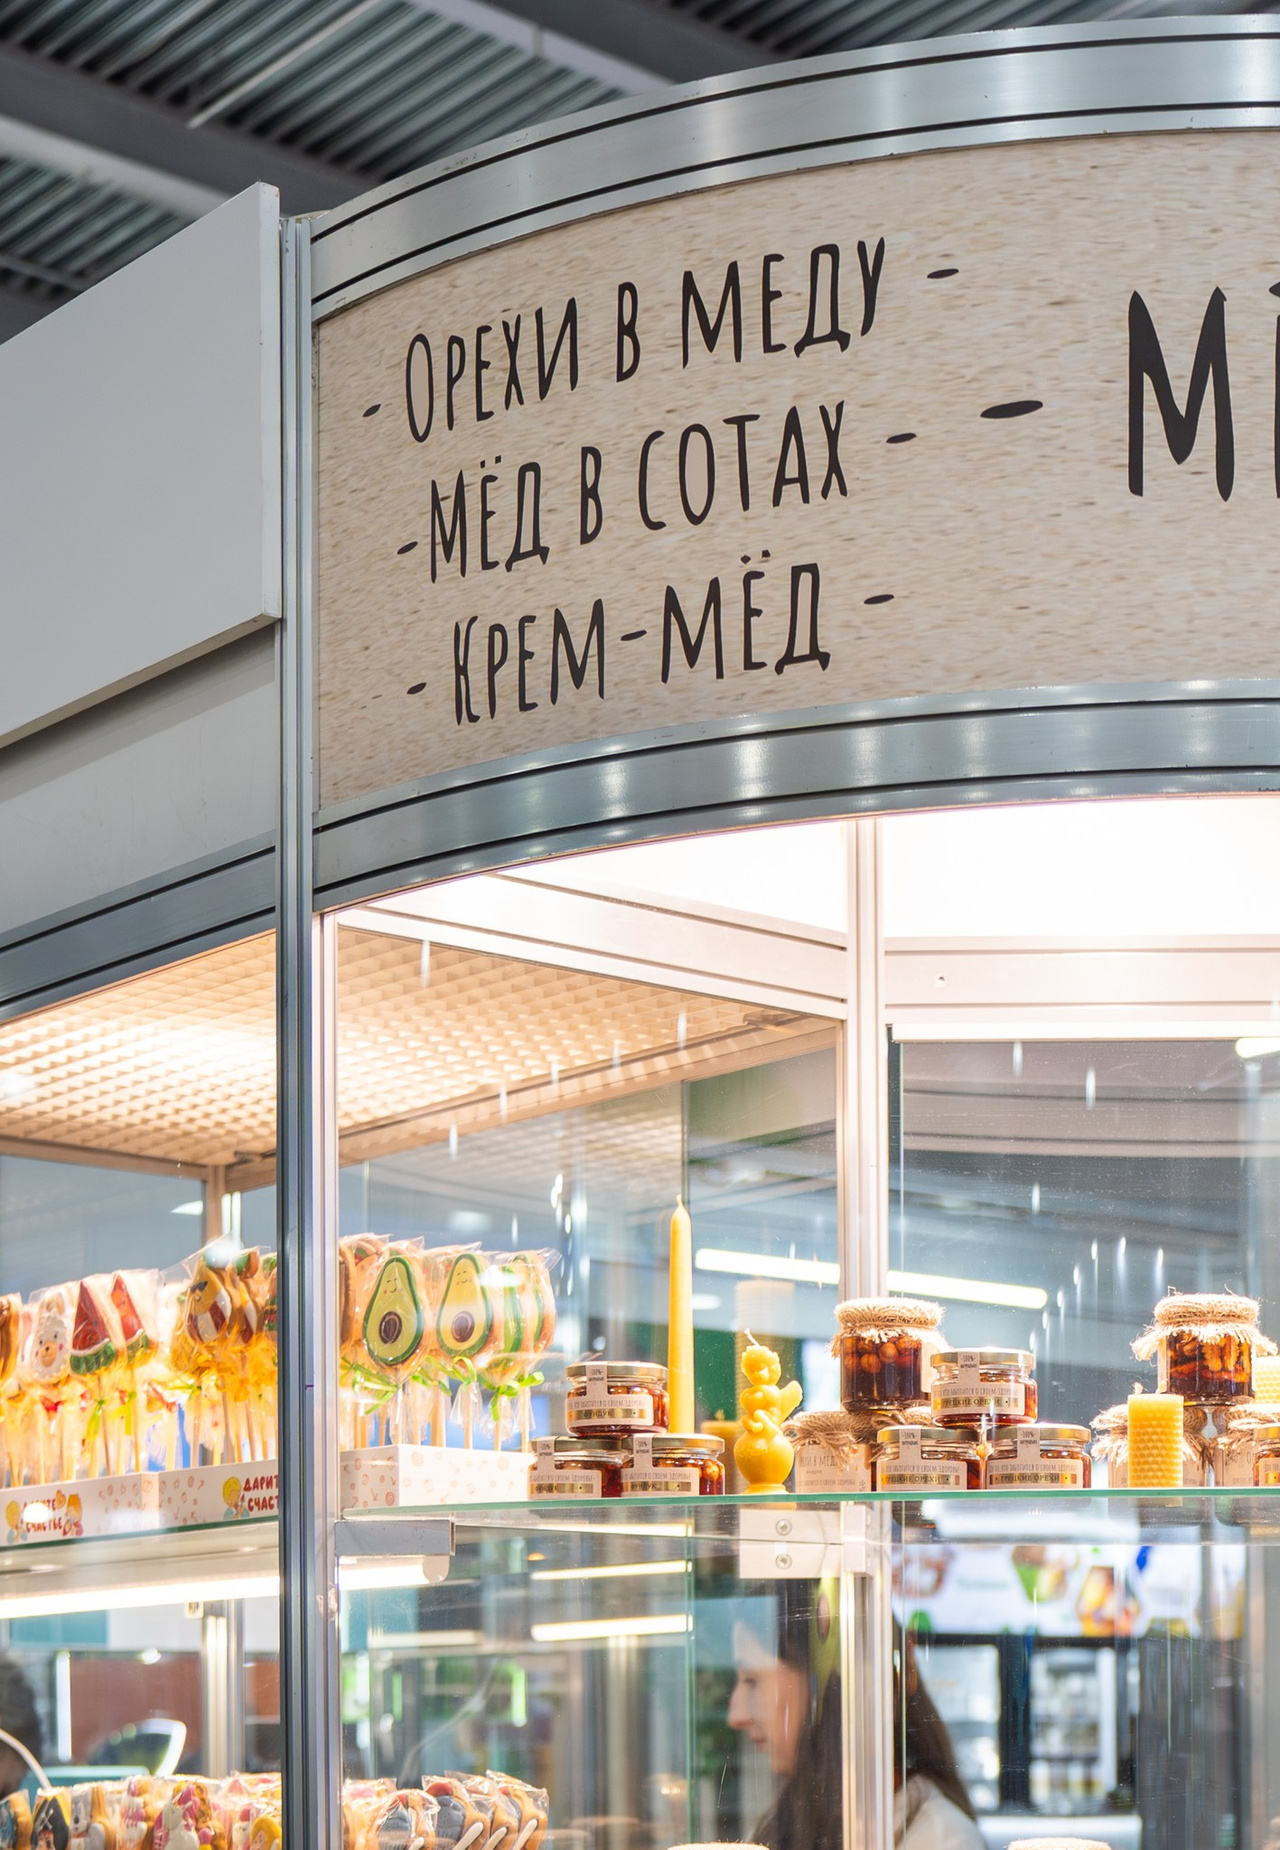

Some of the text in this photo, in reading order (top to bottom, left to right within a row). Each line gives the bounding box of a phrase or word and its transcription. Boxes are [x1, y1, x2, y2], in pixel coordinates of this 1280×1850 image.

[405, 236, 885, 442] ОРЕХИ В МЕДУ
[430, 400, 848, 584] МЁД В СОТАХ
[454, 549, 831, 726] КРЕМ-МЁД
[583, 1409, 612, 1418] ФУНДУК
